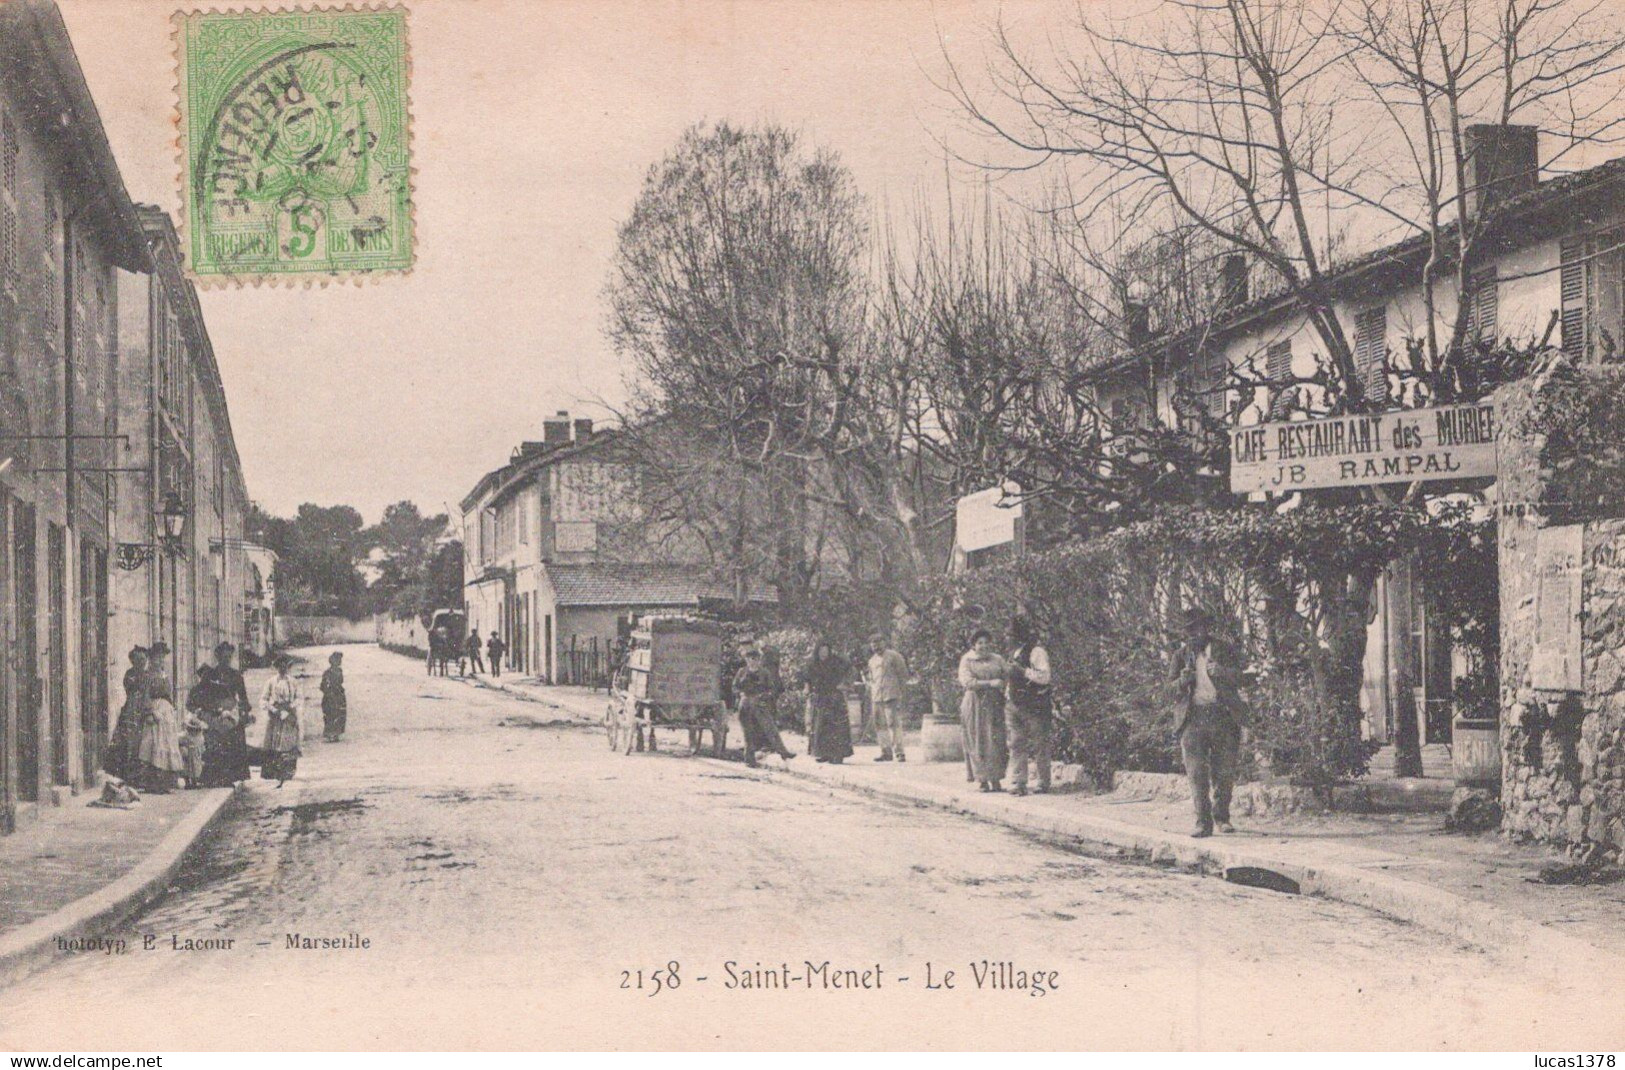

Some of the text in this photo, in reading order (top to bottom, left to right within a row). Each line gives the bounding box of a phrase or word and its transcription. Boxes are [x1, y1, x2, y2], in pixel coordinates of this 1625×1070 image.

[262, 16, 328, 31] POSTES
[289, 204, 316, 258] 5
[1278, 417, 1383, 460] RESTAURANT
[1393, 418, 1423, 450] des
[1339, 453, 1461, 480] RAMPAL
